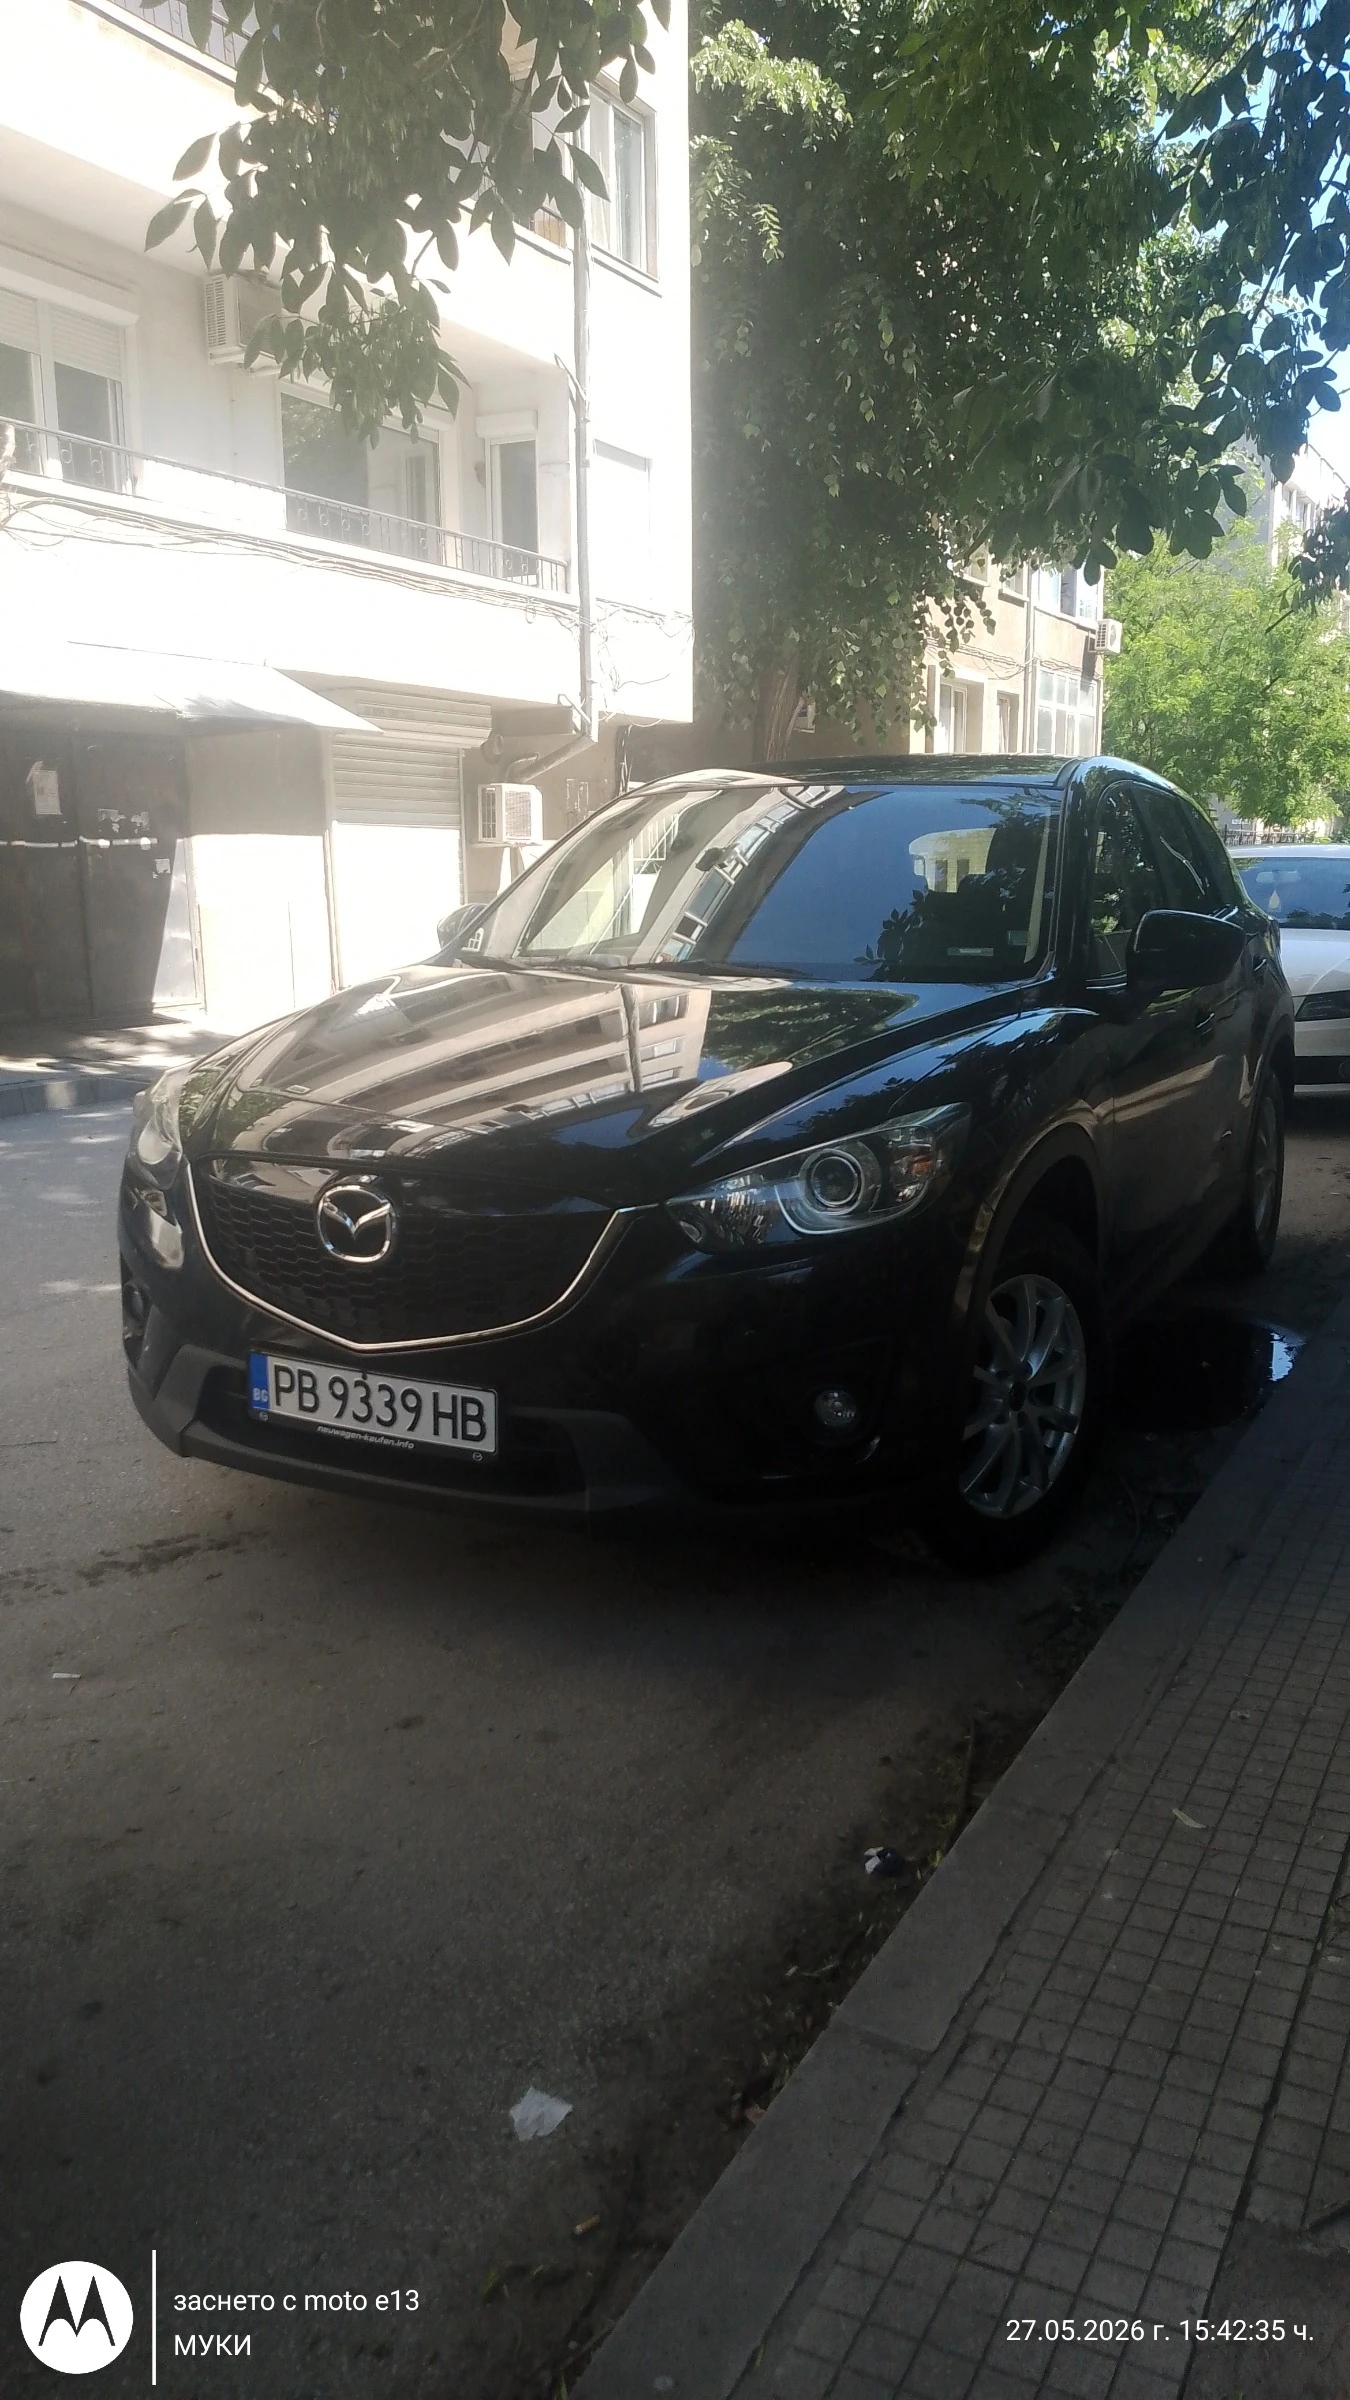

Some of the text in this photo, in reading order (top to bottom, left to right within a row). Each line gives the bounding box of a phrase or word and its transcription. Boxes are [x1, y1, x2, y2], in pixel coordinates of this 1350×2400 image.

[253, 1388, 268, 1401] BG
[274, 1365, 487, 1442] PB 9339 HB
[317, 1425, 415, 1449] neuwagen-kaufen.info
